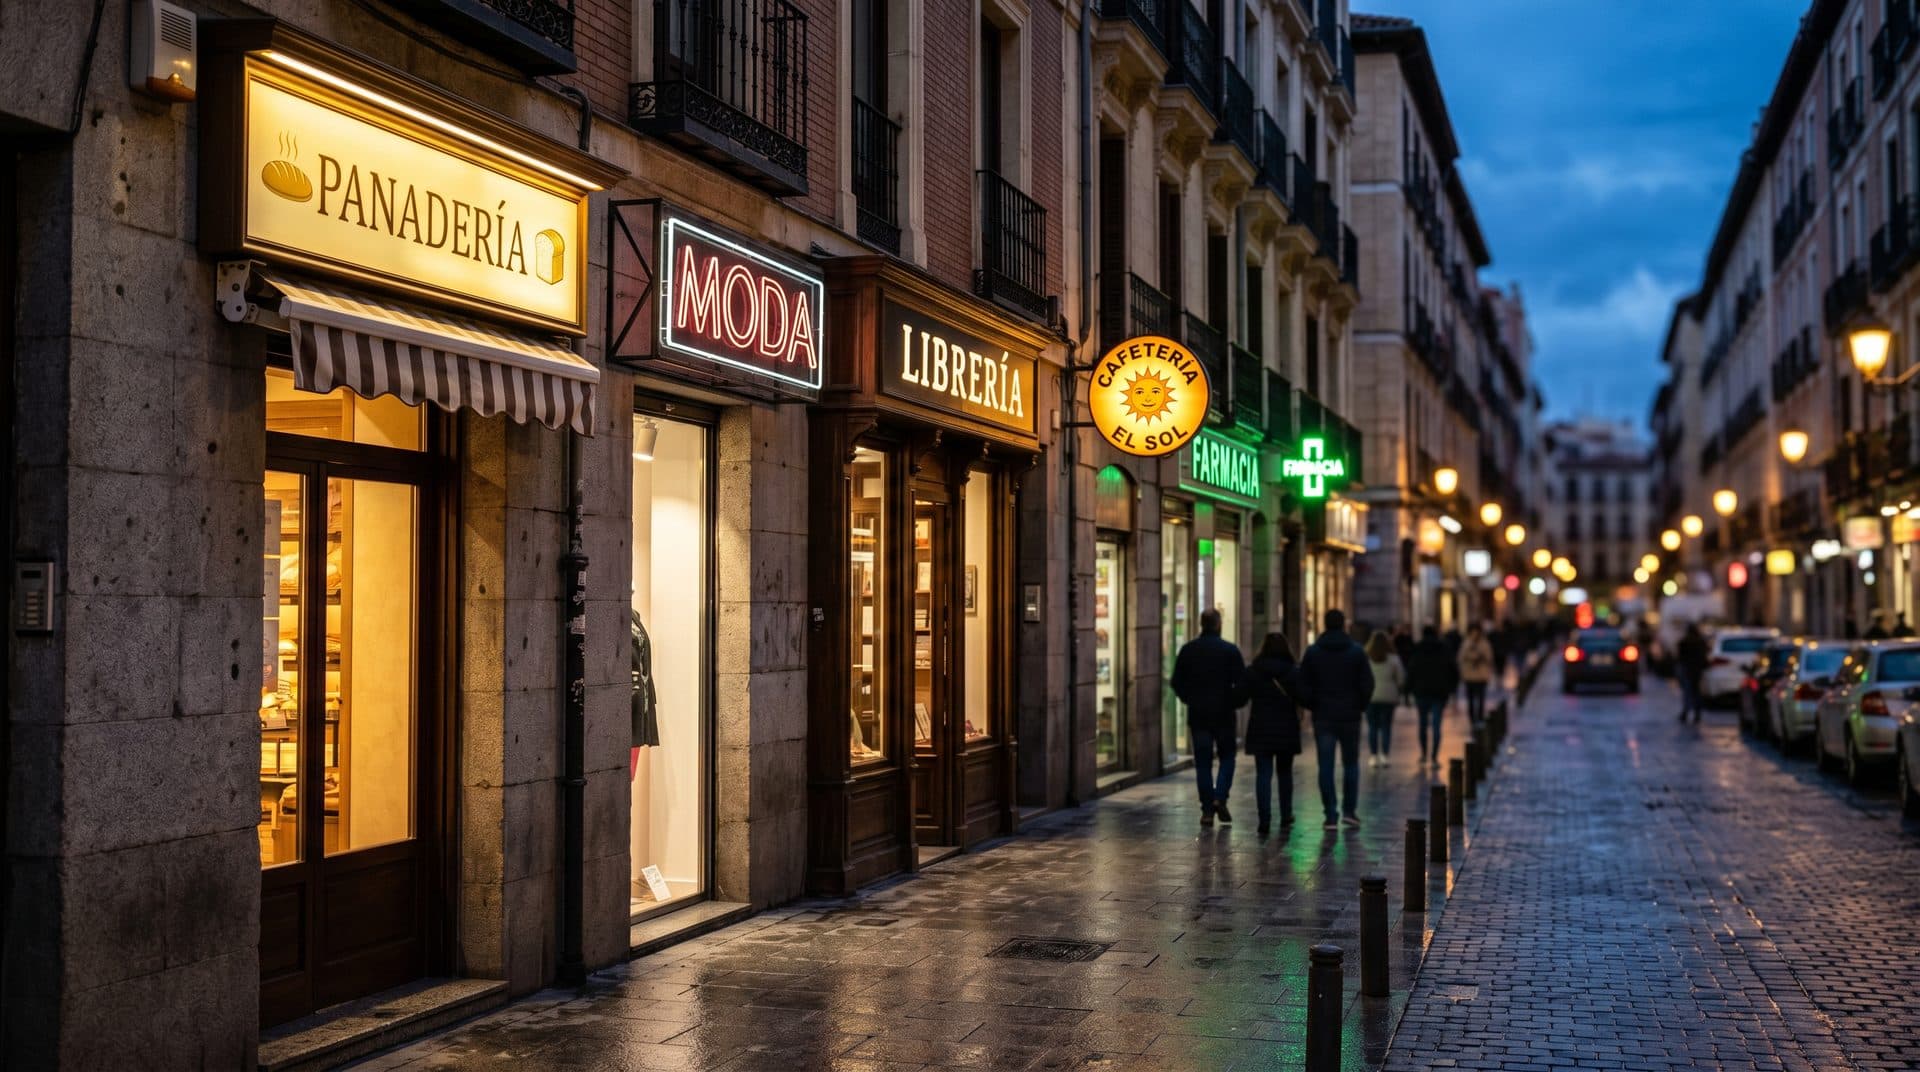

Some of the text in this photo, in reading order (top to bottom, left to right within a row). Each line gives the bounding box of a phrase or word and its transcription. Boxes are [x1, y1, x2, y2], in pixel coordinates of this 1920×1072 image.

[317, 153, 528, 275] PANADERÍA
[677, 245, 818, 369] MODA
[902, 324, 1024, 418] LIBRERÍA
[1098, 343, 1199, 388] CAFETERÍA
[1111, 425, 1188, 451] EL SOL
[1192, 435, 1260, 499] FARMACIA
